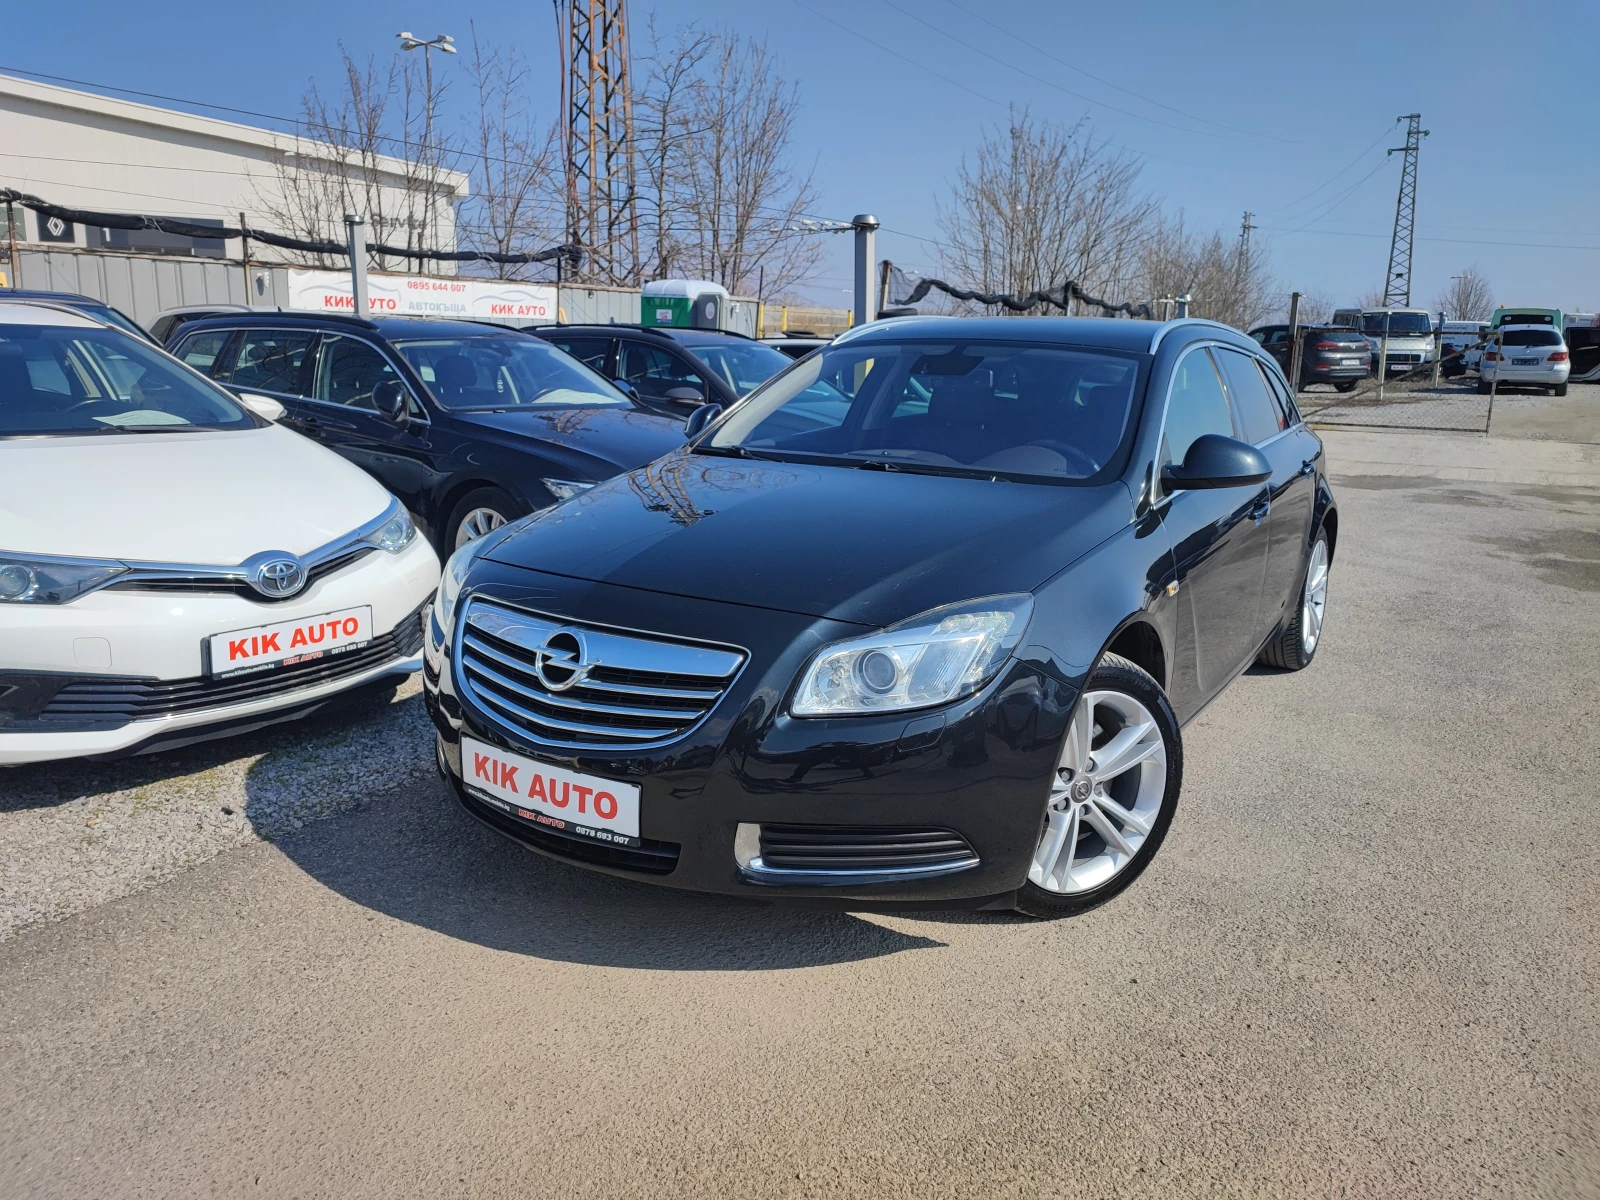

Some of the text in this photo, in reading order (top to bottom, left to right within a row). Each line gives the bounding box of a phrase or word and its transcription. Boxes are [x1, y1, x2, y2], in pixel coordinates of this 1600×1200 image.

[407, 280, 466, 292] 0895 644 007
[408, 301, 467, 312] АВТОКЪЩА
[491, 304, 546, 316] КИК АУТО
[228, 617, 359, 661] KIK AUTO
[300, 652, 323, 662] AUTO
[474, 752, 618, 820] KIK AUTO
[518, 808, 565, 829] KIK AUTO
[575, 826, 630, 845] 0878 693 007
